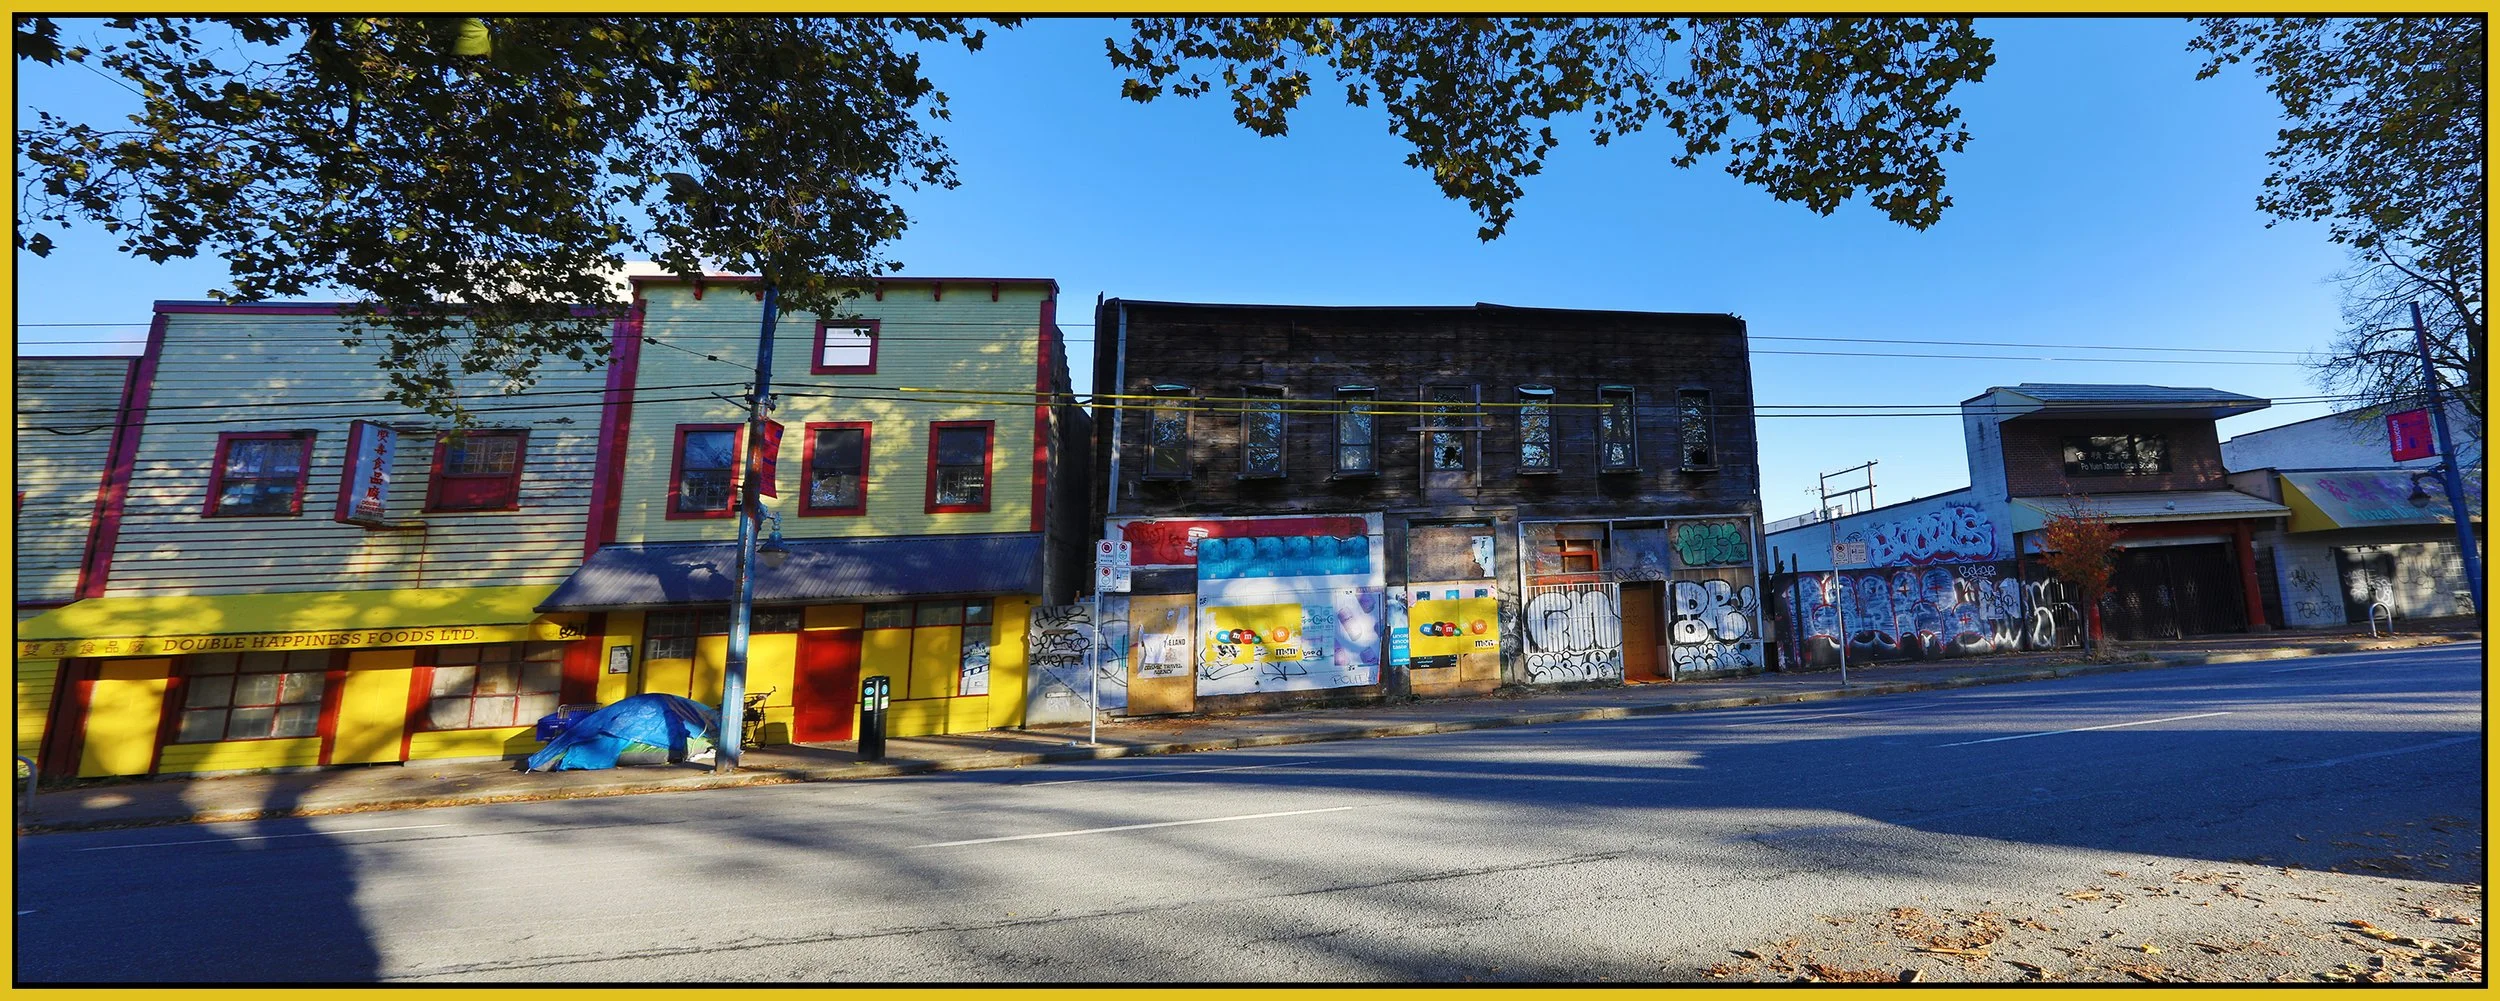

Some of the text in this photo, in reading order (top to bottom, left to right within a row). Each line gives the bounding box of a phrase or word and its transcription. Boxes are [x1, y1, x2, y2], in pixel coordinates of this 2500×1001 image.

[162, 637, 247, 651] DOUBLE
[251, 633, 361, 649] HAPPINESS
[366, 631, 435, 644] FOODS
[439, 629, 479, 641] LTD.
